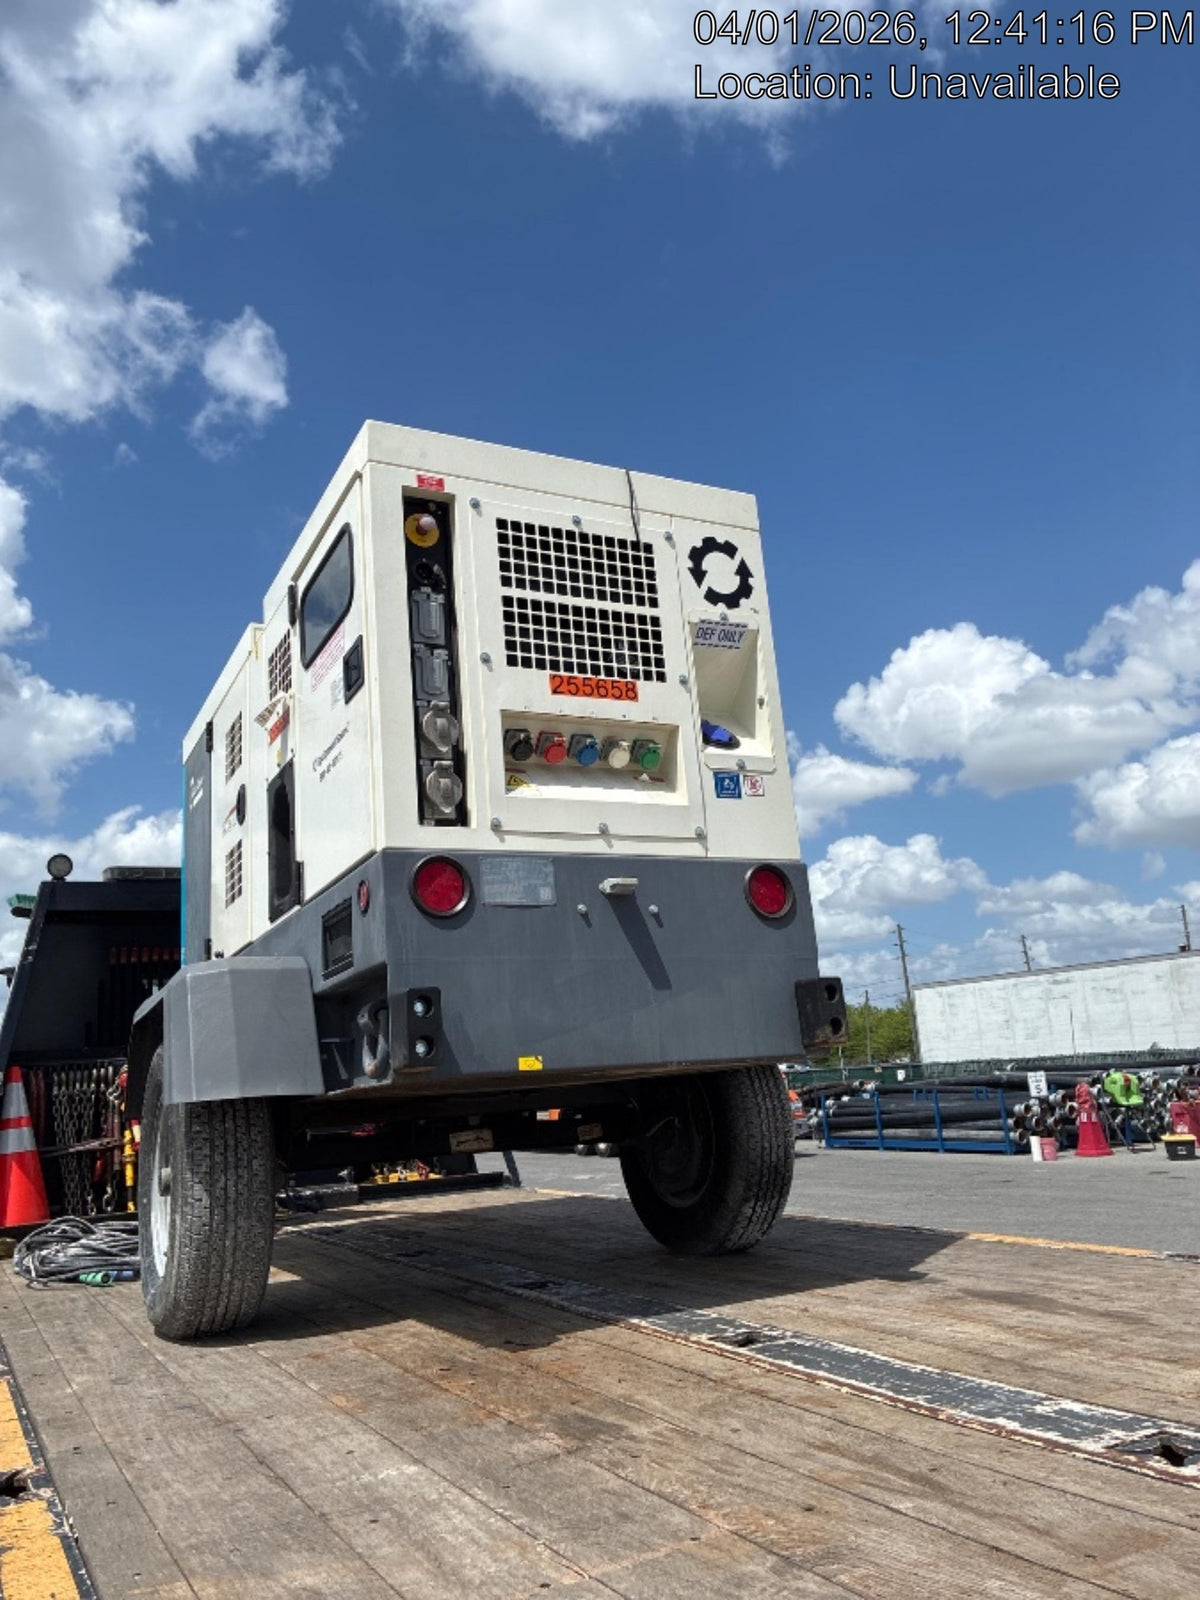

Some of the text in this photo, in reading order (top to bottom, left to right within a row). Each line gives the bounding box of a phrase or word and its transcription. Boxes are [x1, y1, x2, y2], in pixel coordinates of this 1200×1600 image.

[695, 627, 746, 644] DEF ONLY
[551, 675, 637, 700] 255658
